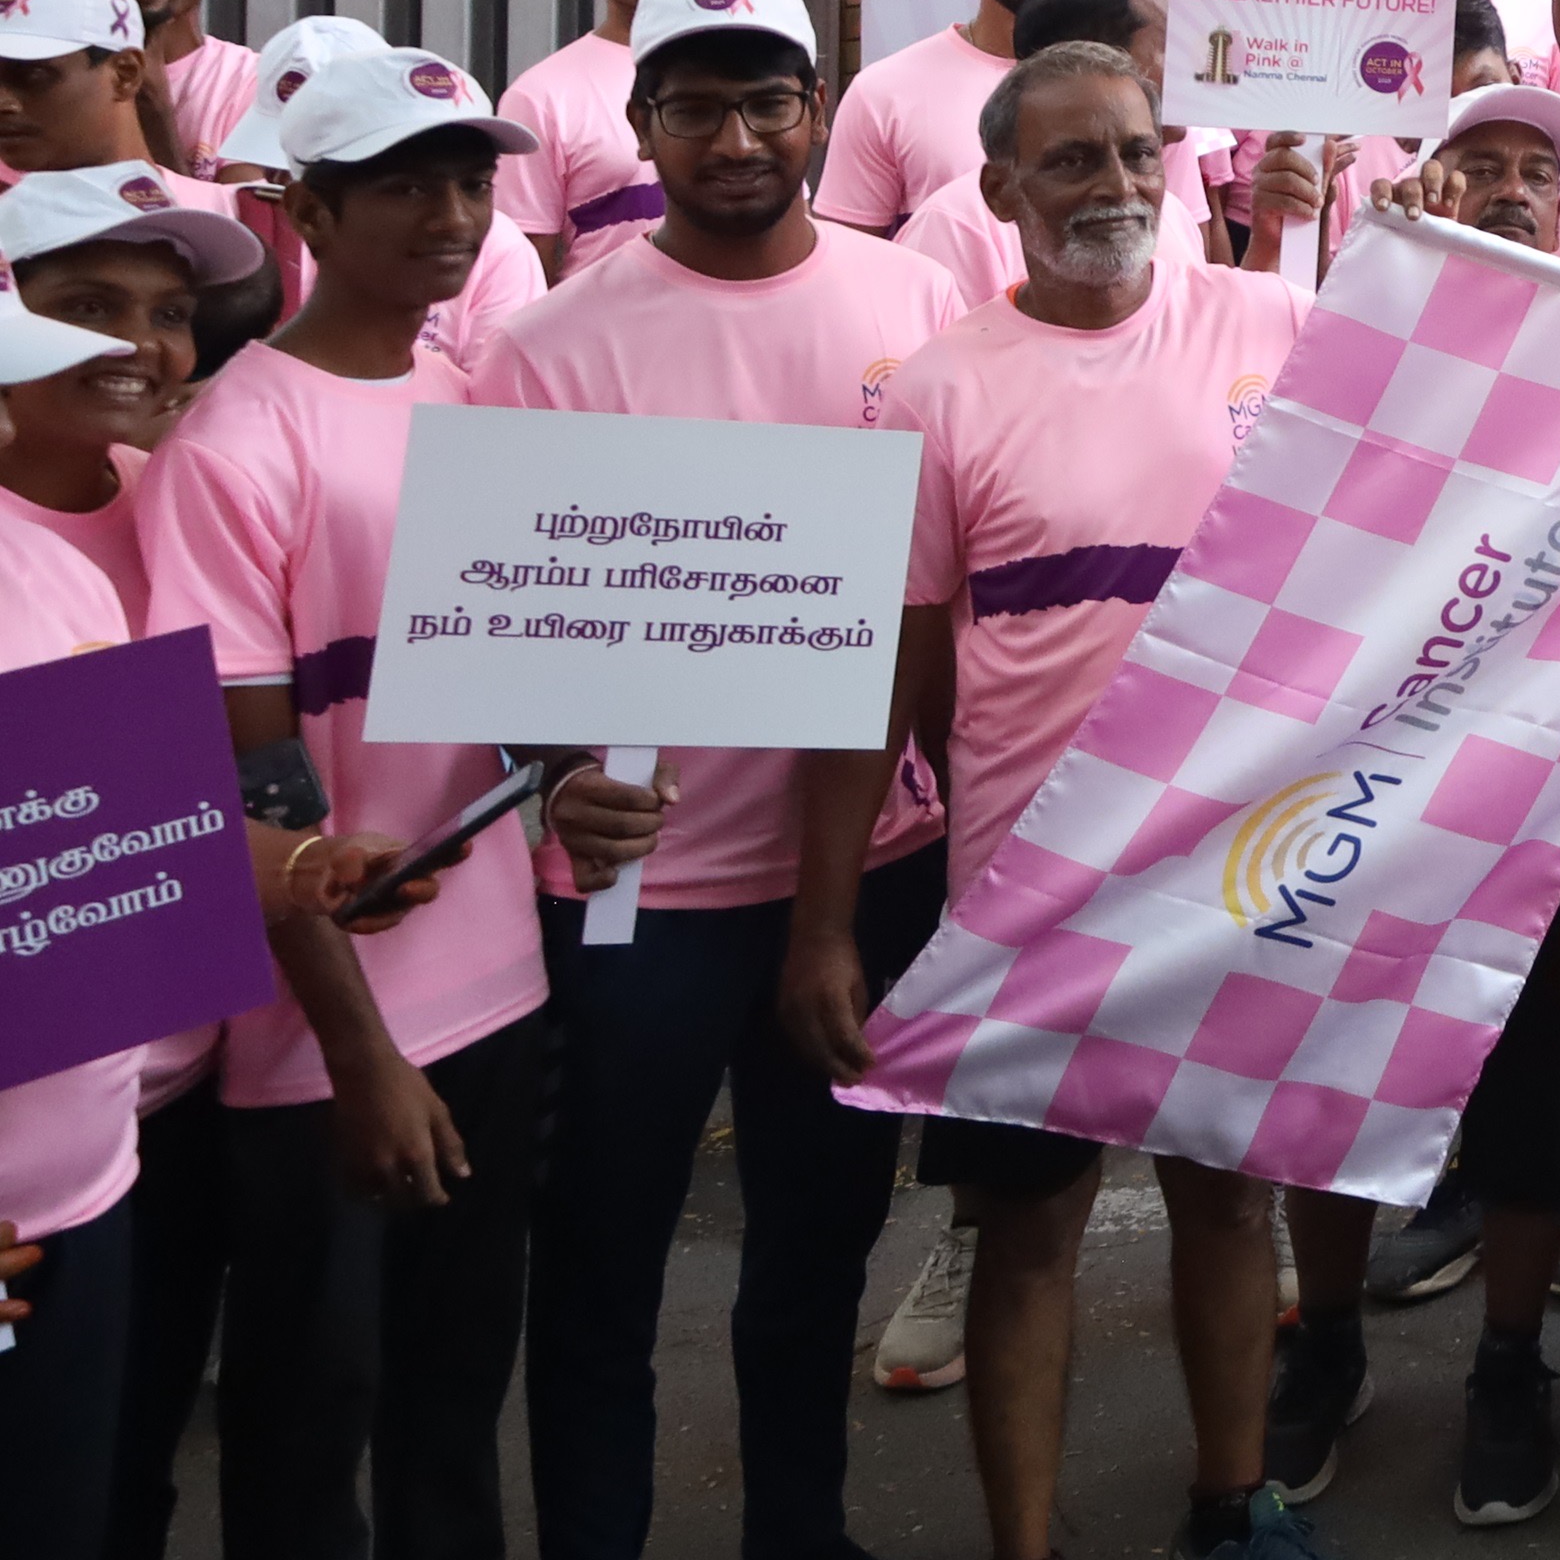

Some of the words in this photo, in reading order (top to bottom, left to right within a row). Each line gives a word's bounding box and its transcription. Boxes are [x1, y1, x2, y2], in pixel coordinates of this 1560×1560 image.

[1245, 53, 1282, 68] Pink
[1246, 37, 1290, 52] Walk
[1293, 39, 1309, 54] in
[1366, 57, 1388, 67] ACT
[1390, 58, 1402, 68] IN
[1243, 69, 1284, 81] Namma
[1286, 71, 1328, 83] Chennai
[534, 504, 789, 547] புற்றுநோயின்
[459, 556, 592, 591] ஆரம்ப
[604, 562, 843, 601] பரிசோதனை
[407, 606, 473, 644] நம்
[487, 612, 632, 648] உயிரை
[643, 617, 875, 653] பாதுகாக்கும்
[1360, 533, 1513, 730] Cancer
[1253, 770, 1403, 948] MGM
